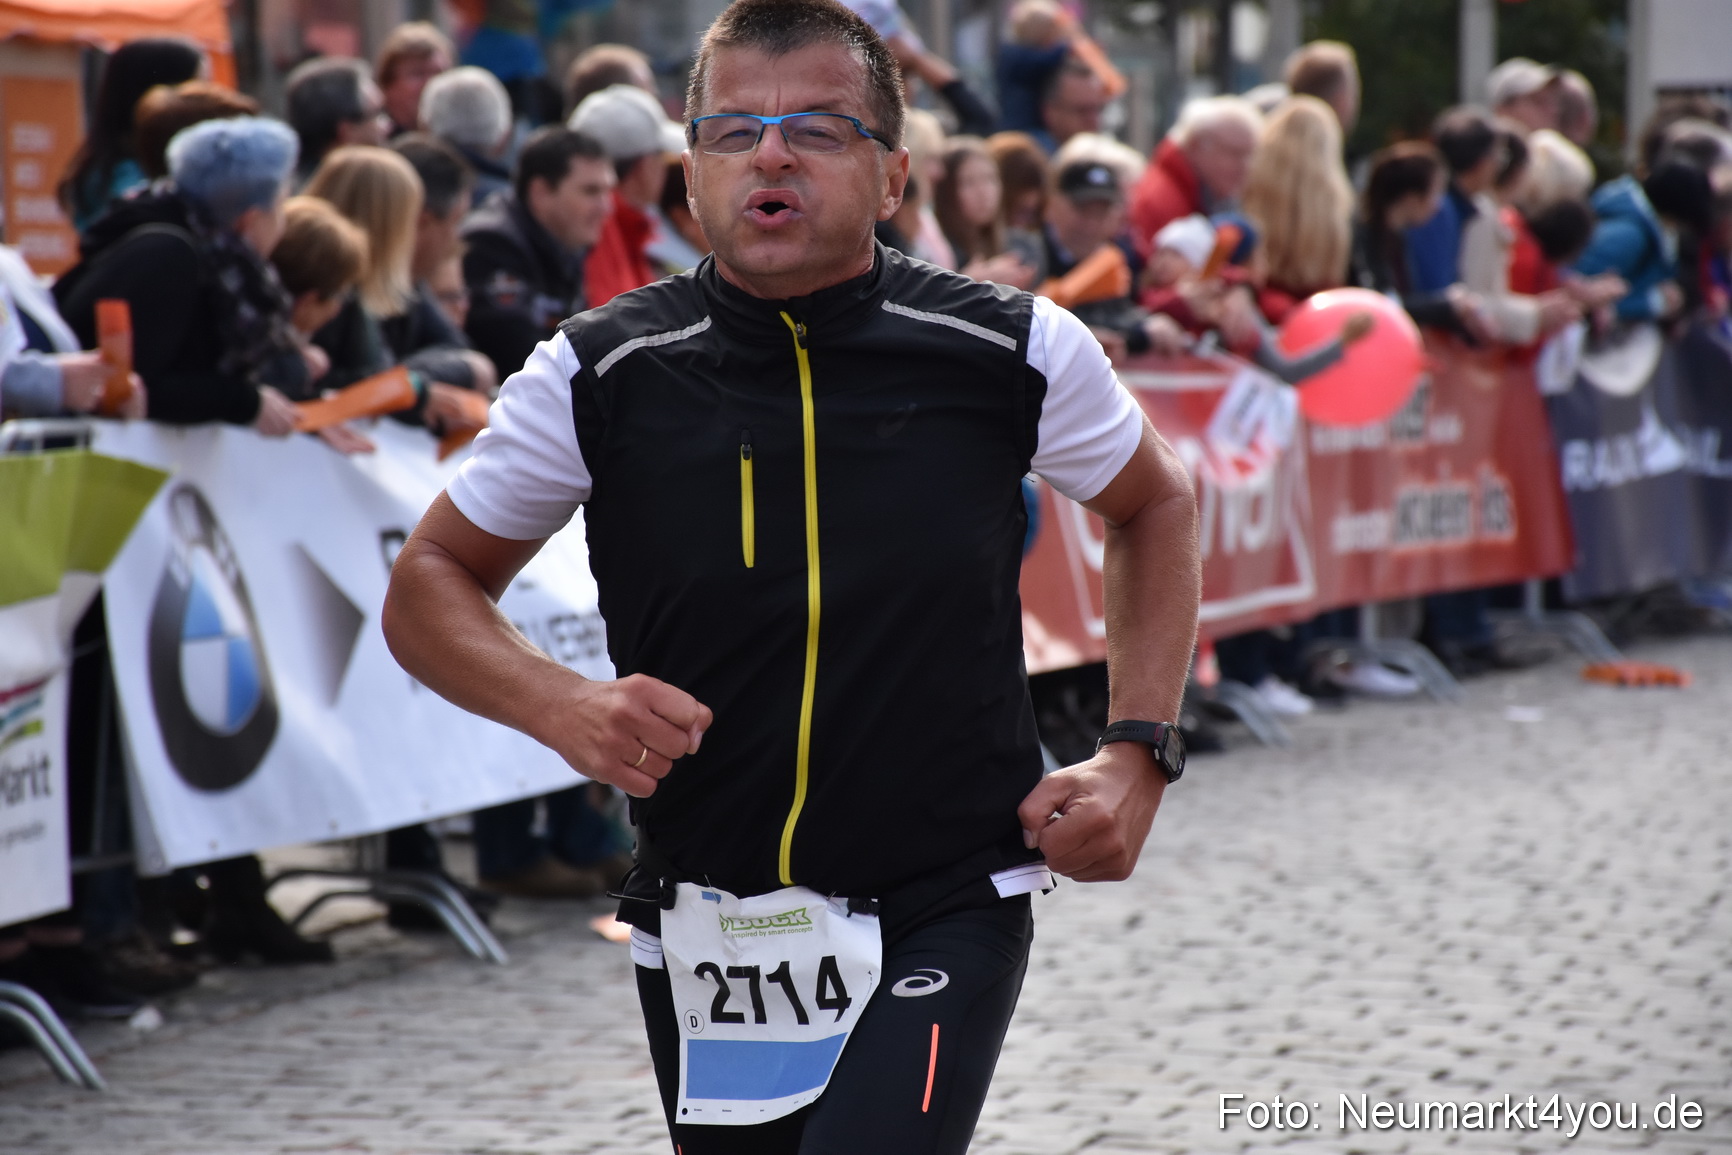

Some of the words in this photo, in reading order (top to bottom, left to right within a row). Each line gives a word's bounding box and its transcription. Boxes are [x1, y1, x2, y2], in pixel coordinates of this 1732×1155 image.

[731, 930, 758, 939] inspired
[759, 929, 767, 937] by
[768, 928, 786, 937] smart
[787, 926, 814, 935] concepts
[694, 955, 852, 1025] 2714
[689, 1015, 699, 1028] D
